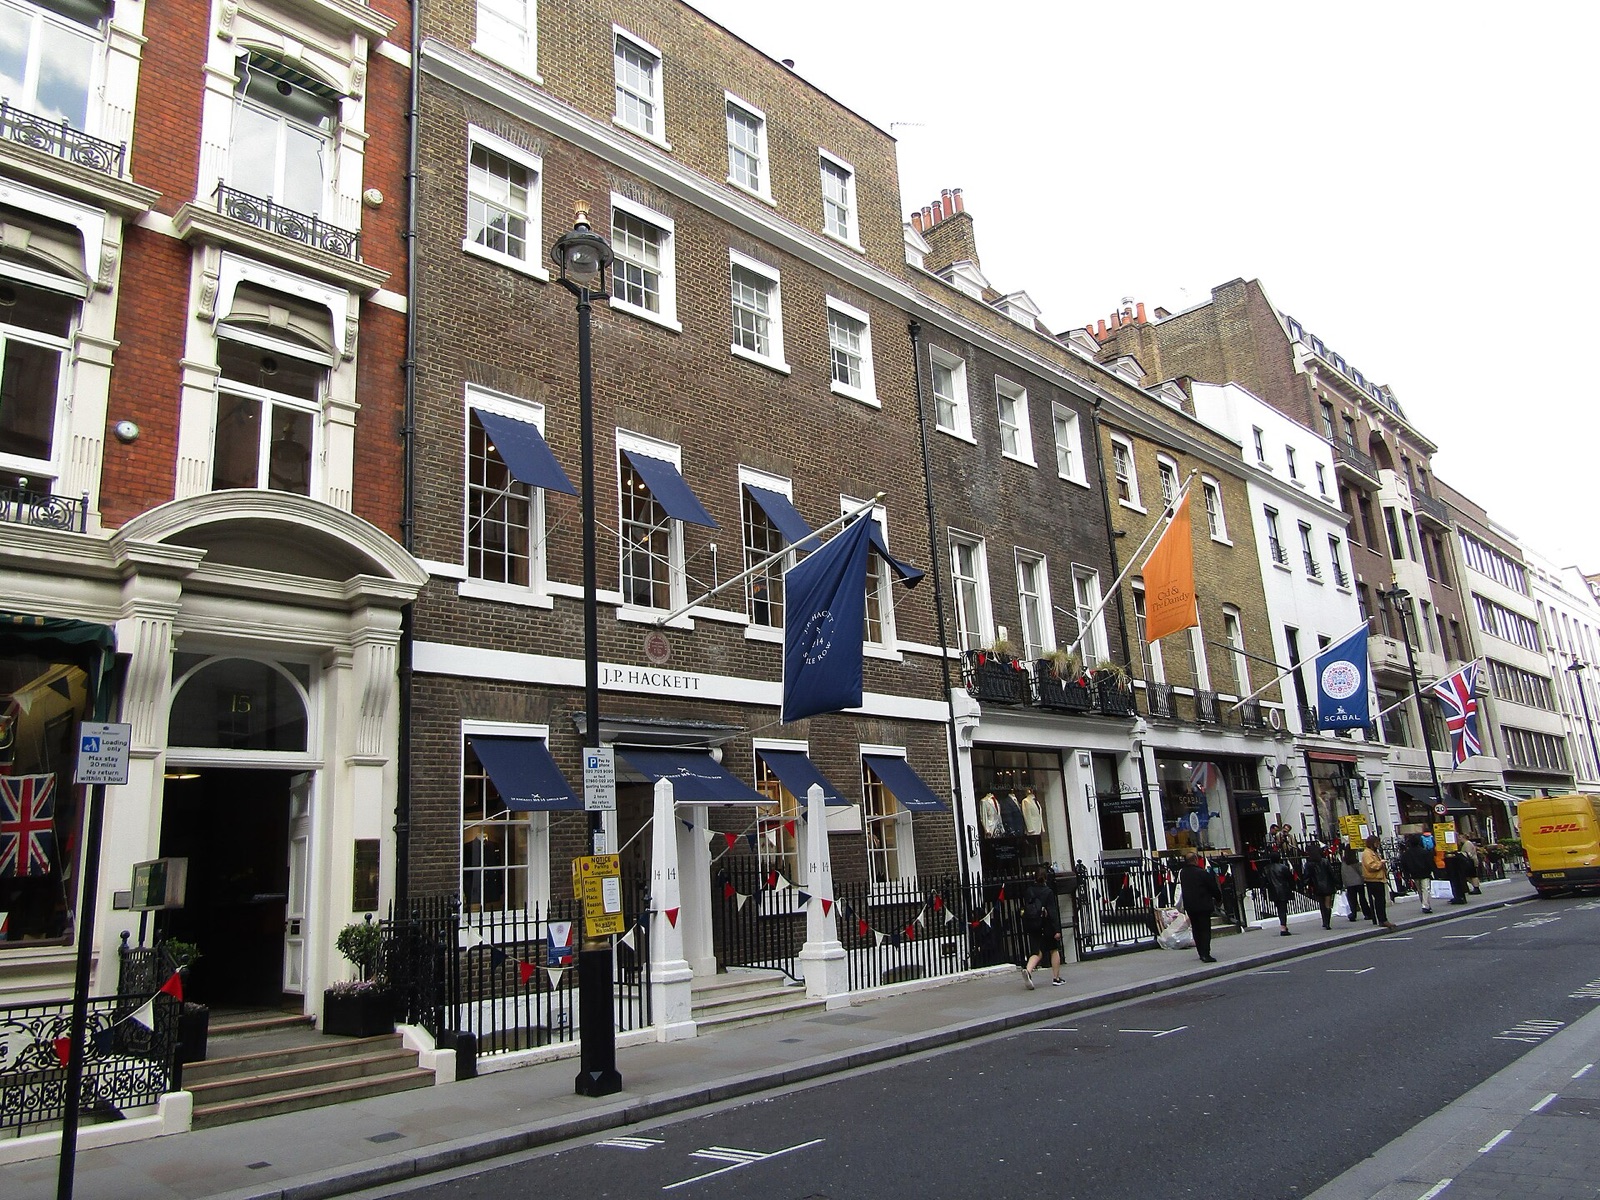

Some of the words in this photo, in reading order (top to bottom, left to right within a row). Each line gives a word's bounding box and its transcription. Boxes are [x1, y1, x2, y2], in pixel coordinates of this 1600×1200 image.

[1163, 592, 1189, 606] Dandy
[602, 668, 623, 685] J.P.
[628, 671, 700, 690] HACKETT
[231, 694, 251, 713] 15
[1324, 714, 1361, 722] SCABAL
[1178, 796, 1203, 805] SCABAL
[1539, 823, 1580, 835] DHL
[809, 862, 818, 873] 14
[822, 861, 829, 873] 14
[654, 869, 661, 880] 14
[667, 868, 676, 880] 14
